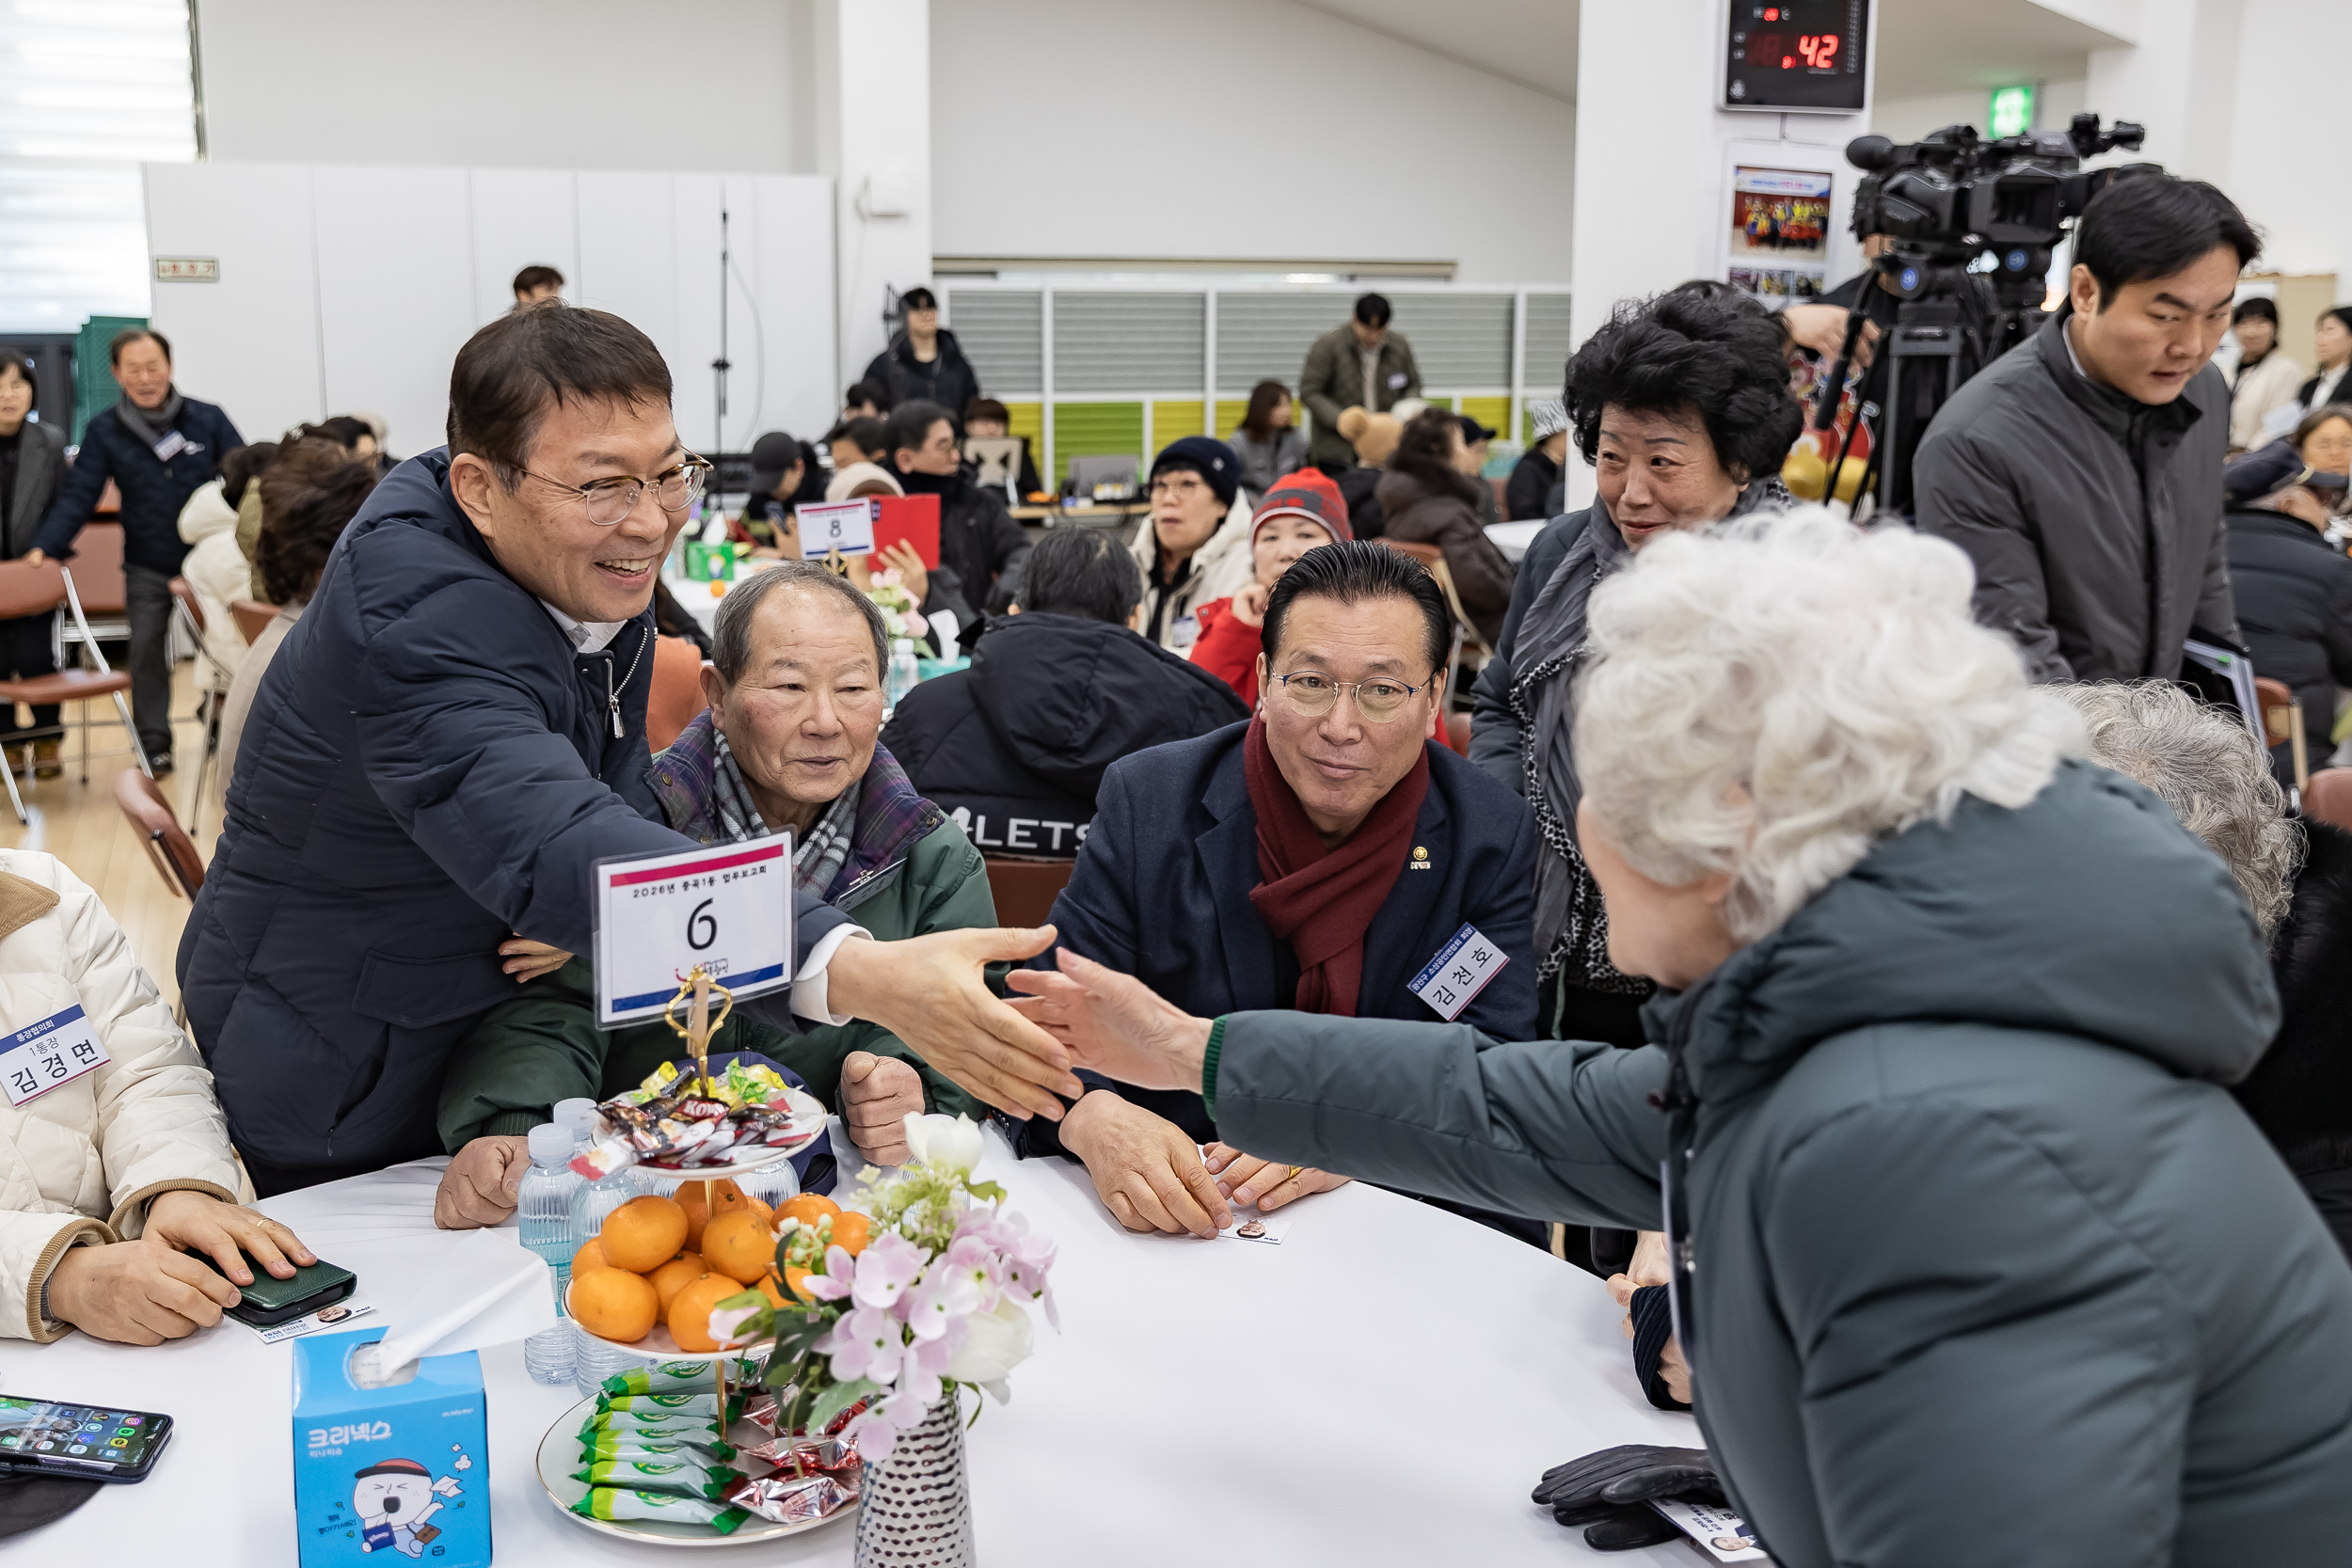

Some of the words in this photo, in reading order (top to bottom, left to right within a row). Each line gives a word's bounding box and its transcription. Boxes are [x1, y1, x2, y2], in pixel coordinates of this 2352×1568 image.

[1798, 34, 1839, 69] 42
[830, 519, 842, 538] 8
[633, 883, 675, 898] 2026년
[723, 865, 767, 883] 업무보고회
[687, 896, 718, 951] 6
[1411, 973, 1429, 991] 광진구
[1428, 939, 1463, 974] 소상공인연합회
[1459, 927, 1474, 941] 회장
[16, 1020, 55, 1041] 통장협의회
[29, 1036, 59, 1056] 1통장
[308, 1420, 392, 1449] 크리넥스
